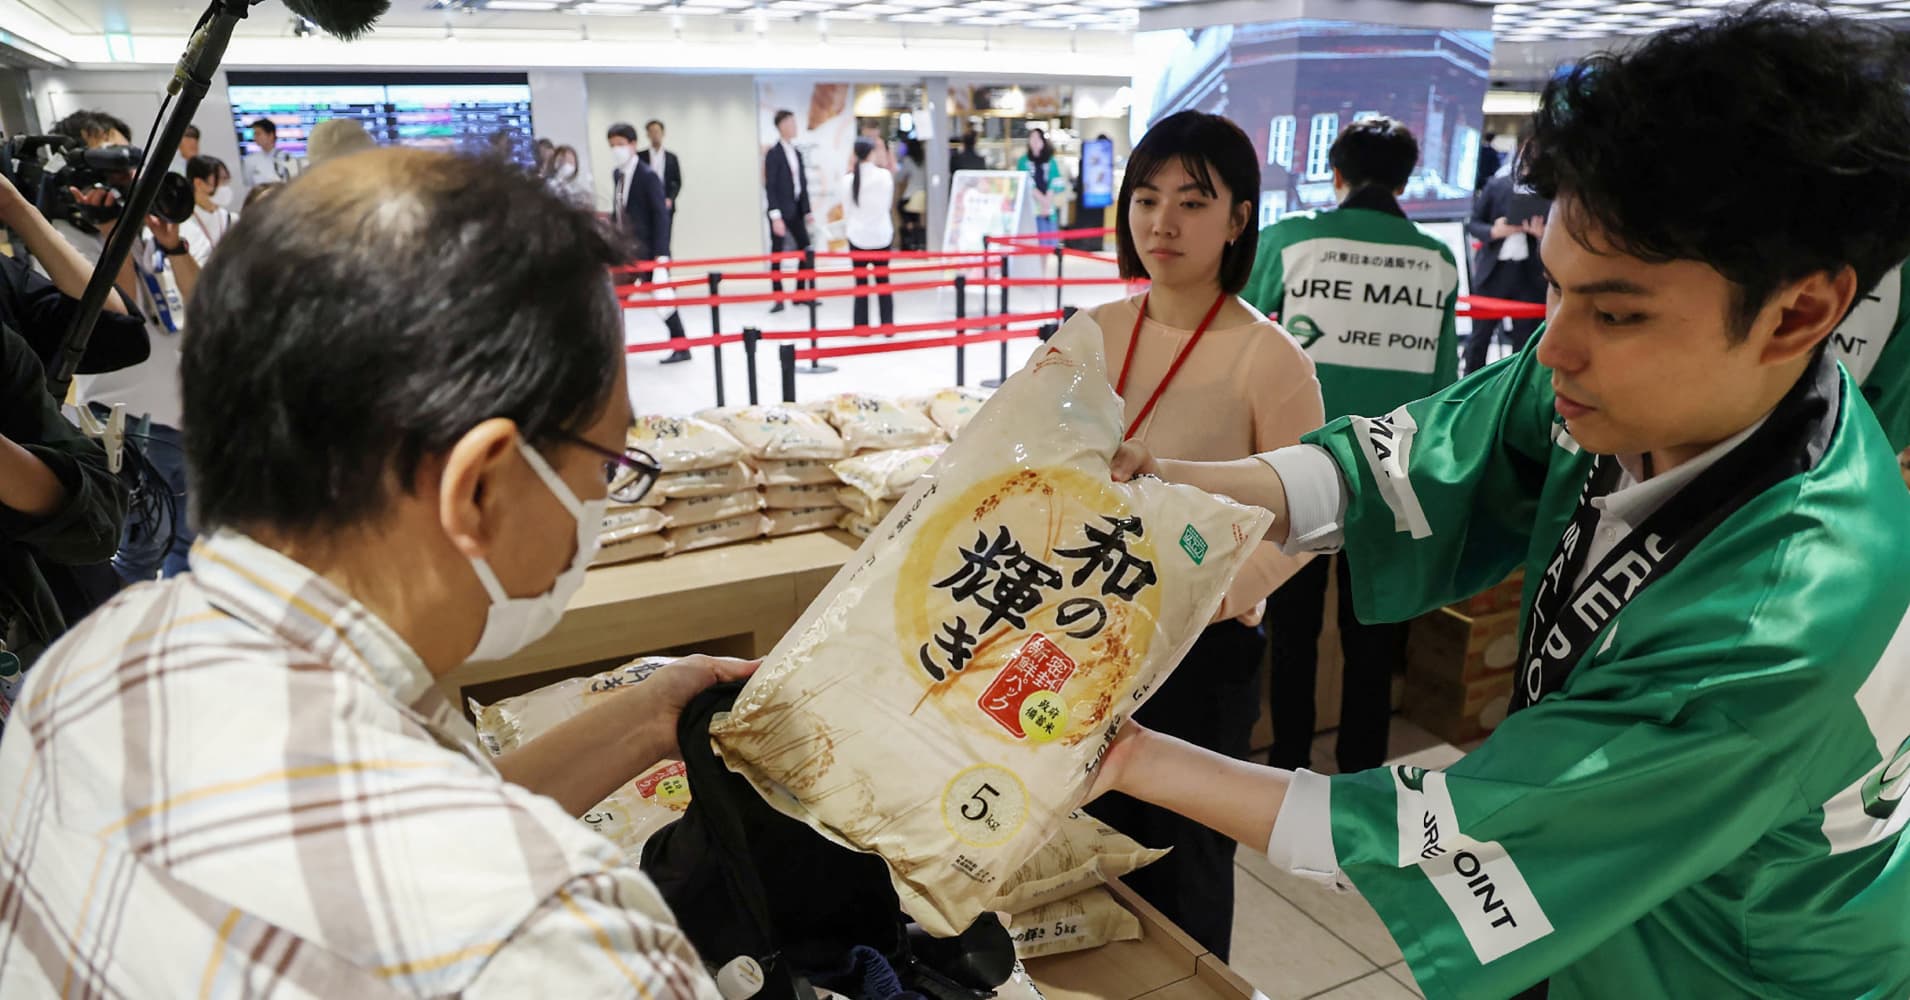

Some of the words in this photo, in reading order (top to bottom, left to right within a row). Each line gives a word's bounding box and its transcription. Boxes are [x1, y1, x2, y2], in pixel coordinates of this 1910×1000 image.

[1320, 250, 1432, 271] JR東日本の通販サイト
[1291, 279, 1353, 300] JRE
[1363, 283, 1446, 309] MALL
[1338, 330, 1382, 347] JRE
[1388, 333, 1440, 351] POIN
[1572, 532, 1678, 632] JRE
[989, 639, 1051, 711] 新鮮パック
[1525, 621, 1572, 708] PO
[1024, 706, 1056, 735] 備蓄米
[1037, 699, 1060, 720] 政府
[1420, 810, 1447, 860] JRE
[1453, 849, 1518, 929] OINT
[1054, 921, 1078, 936] 5kg
